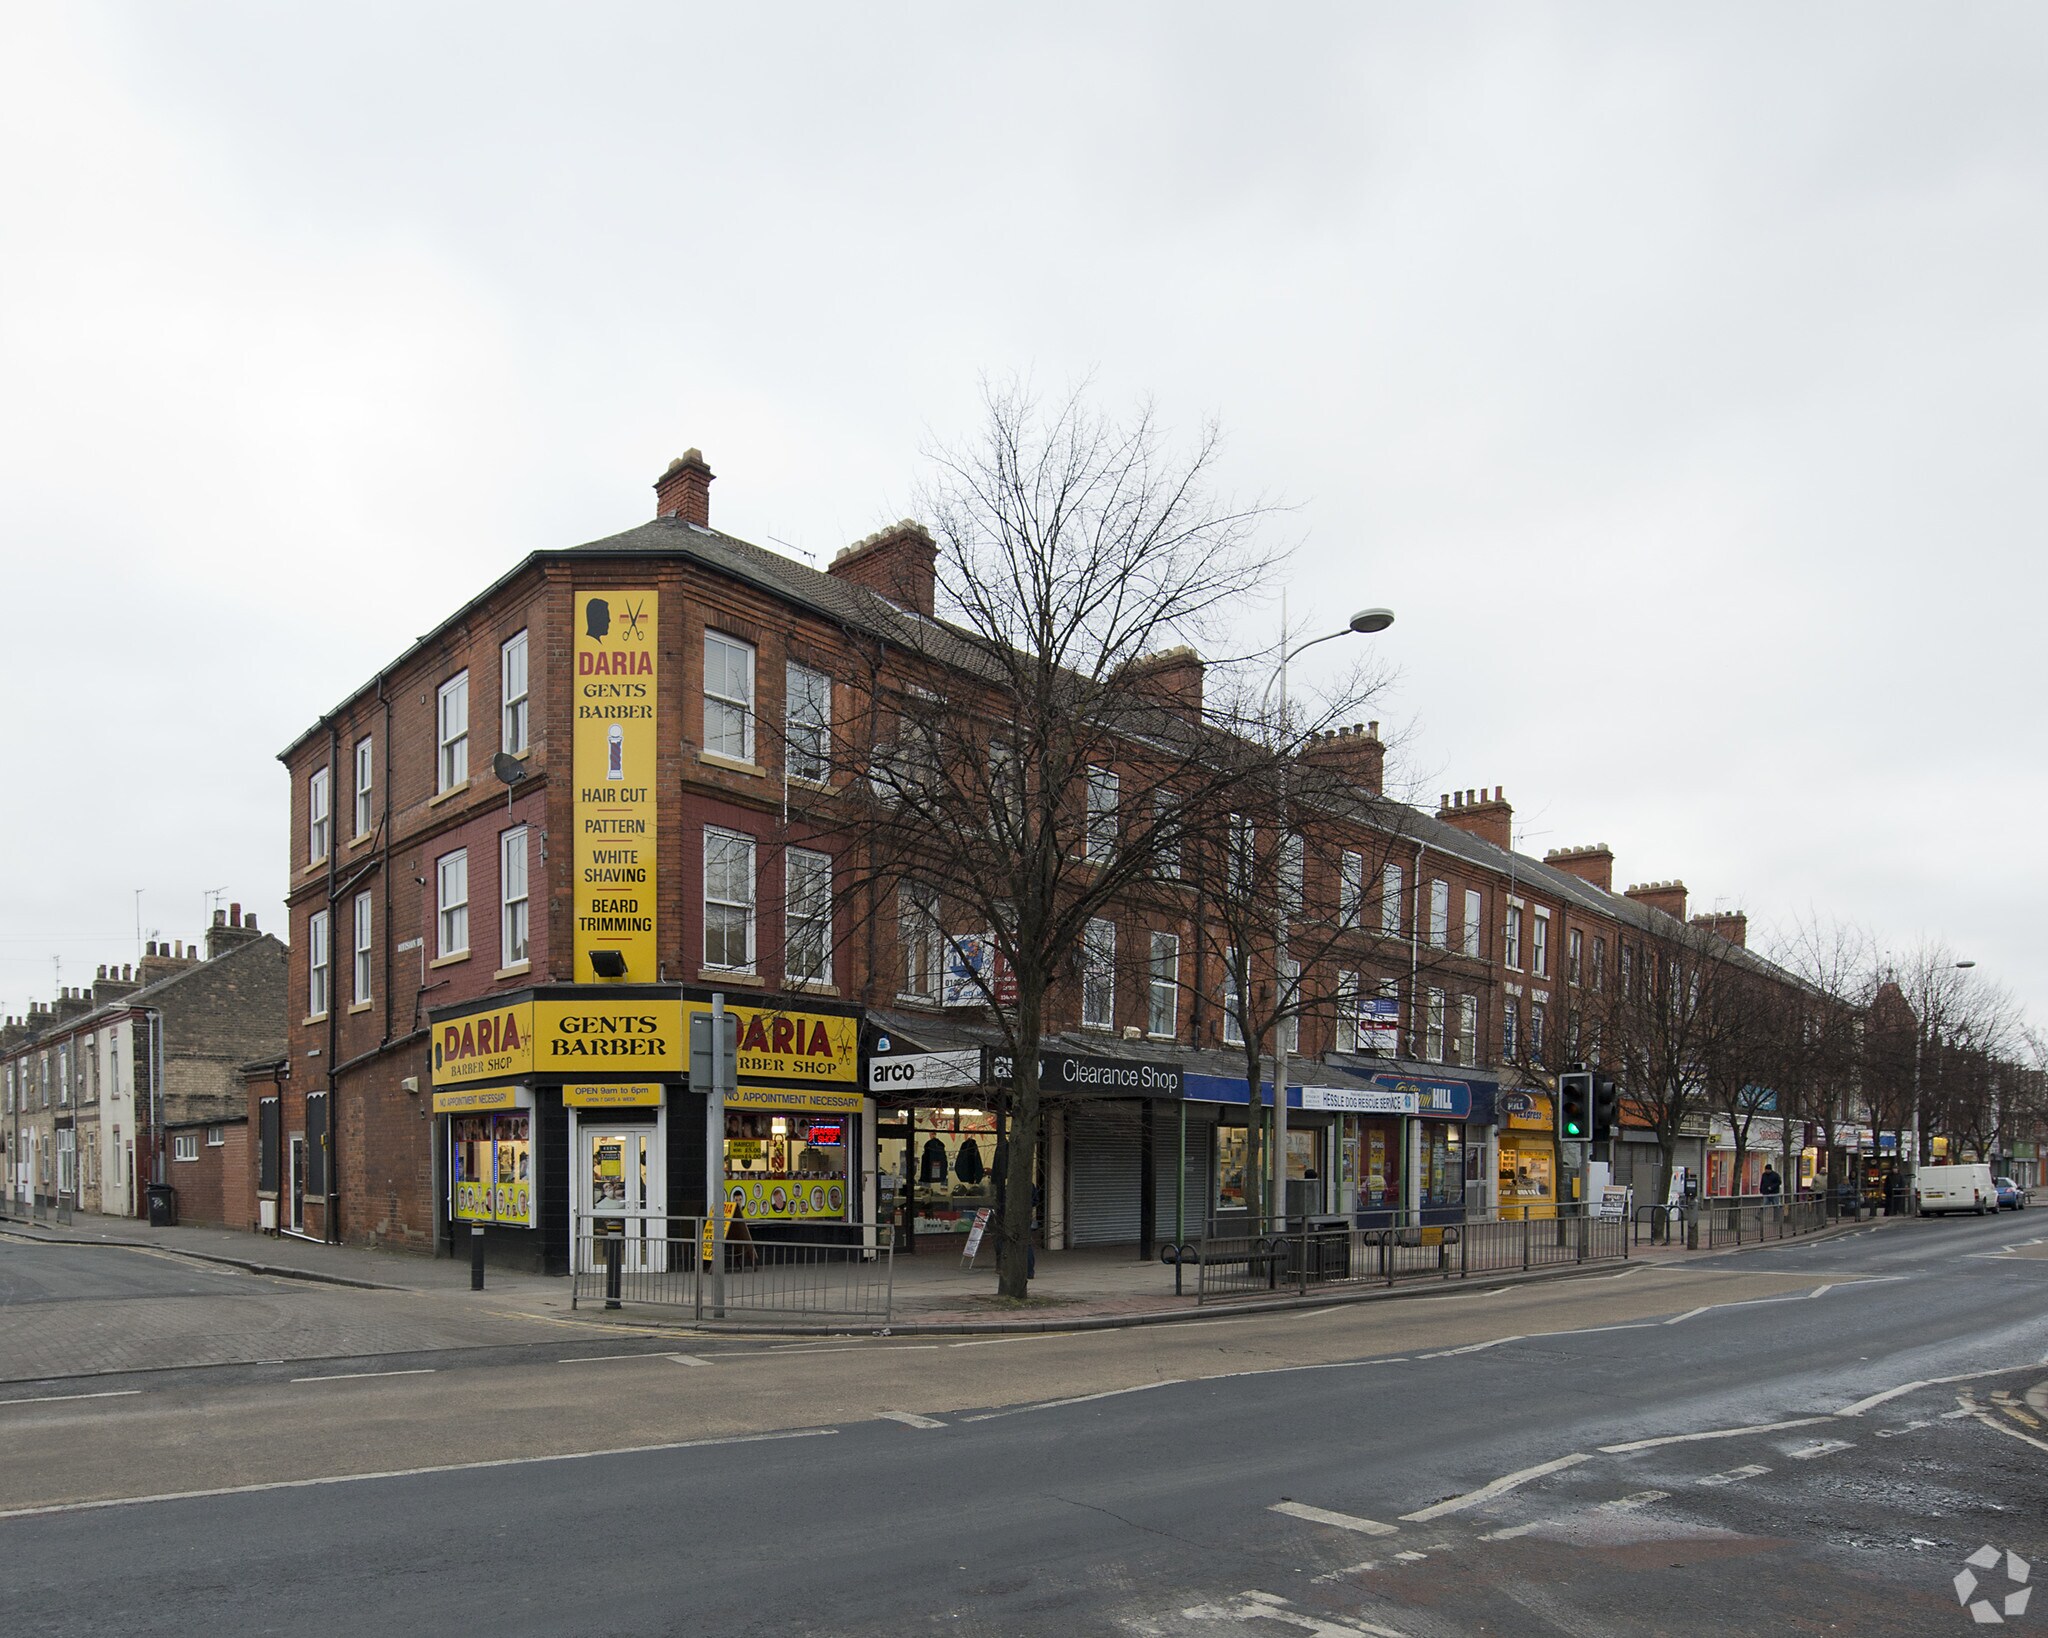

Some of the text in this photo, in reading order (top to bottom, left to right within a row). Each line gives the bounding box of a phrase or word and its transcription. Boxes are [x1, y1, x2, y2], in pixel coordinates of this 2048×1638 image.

[579, 651, 653, 675] DARIA
[583, 684, 647, 697] GENTS
[579, 705, 653, 719] BARBER
[582, 788, 648, 802] HAIR CUT
[585, 819, 646, 833] PATTERN
[592, 850, 638, 864] WHITE
[584, 868, 646, 882] SHAVING
[592, 899, 638, 913] BEARD
[578, 917, 652, 932] TRIMMING
[559, 1016, 657, 1034] GENTS
[445, 1012, 521, 1062] DARIA
[551, 1038, 667, 1055] BARBER
[451, 1056, 513, 1077] BARBER SHOP
[739, 1057, 838, 1075] RBER SHOP
[873, 1063, 915, 1082] arco
[1063, 1059, 1139, 1086] Clearance
[1141, 1066, 1178, 1094] Shop
[575, 1086, 649, 1095] OPEN 9am to 6pm
[440, 1092, 507, 1107] NO APPOINTMENT NECESSARY
[725, 1092, 859, 1107] NO APPOINTMENT NECESSARY
[1322, 1092, 1345, 1107] HESSLE
[1346, 1096, 1358, 1108] DOG
[1358, 1098, 1379, 1109] RESCUE
[1380, 1096, 1401, 1109] SERVICE
[1432, 1088, 1453, 1110] HILL
[817, 1135, 837, 1143] SHOP
